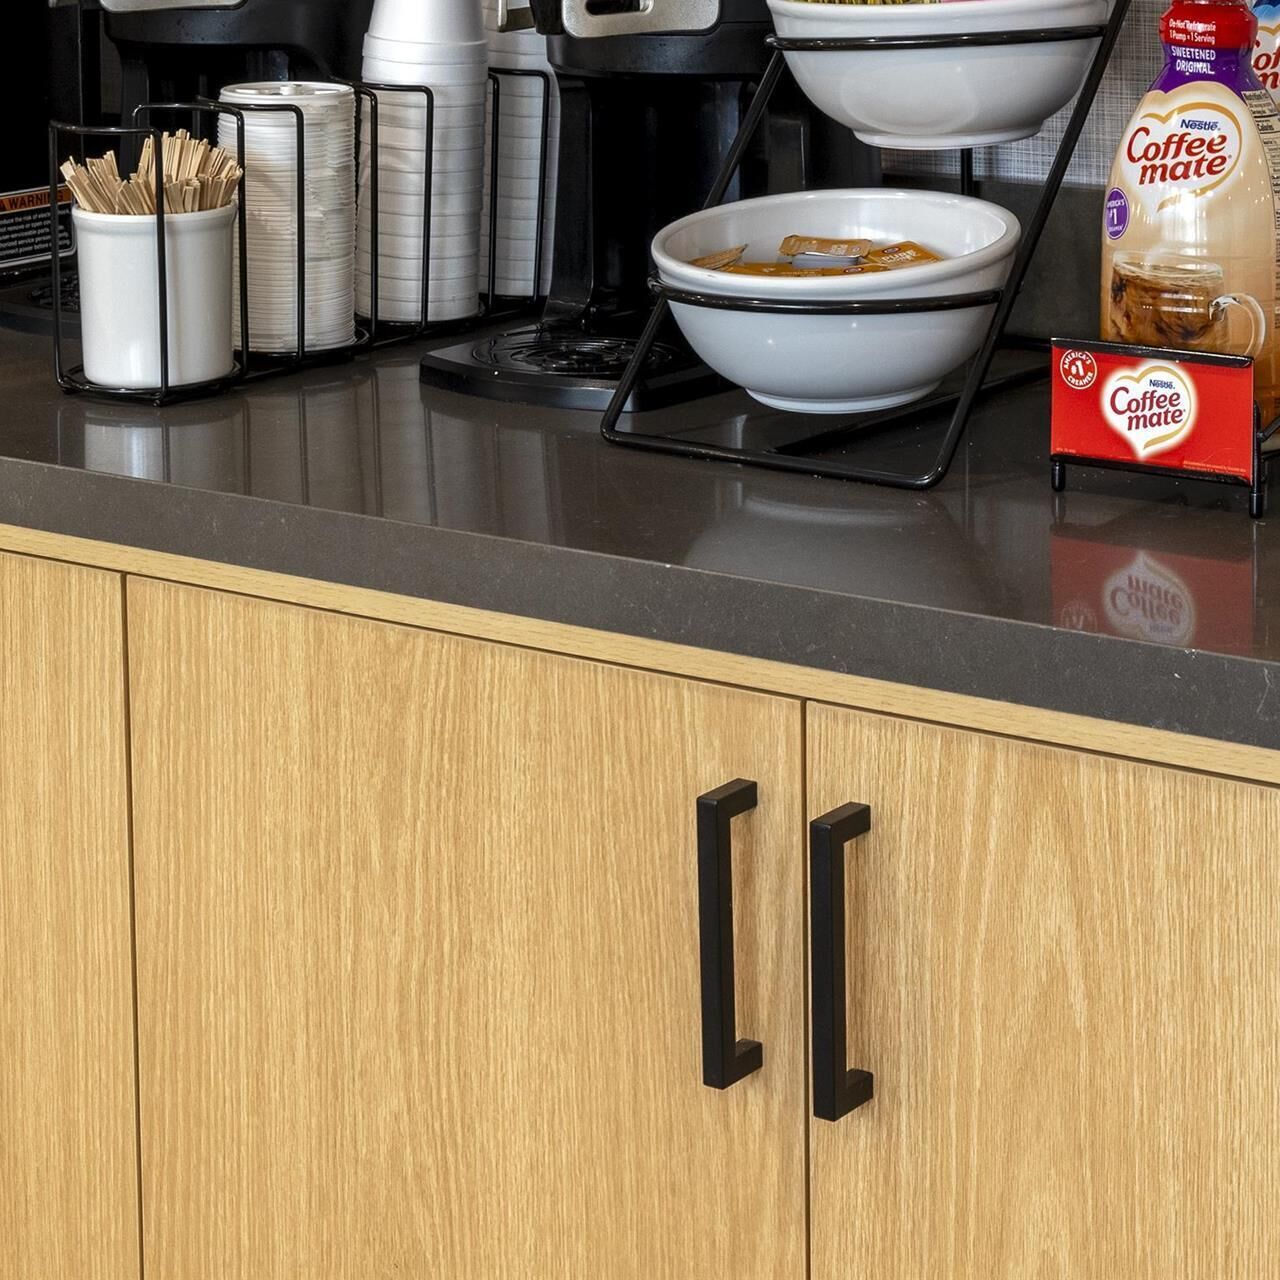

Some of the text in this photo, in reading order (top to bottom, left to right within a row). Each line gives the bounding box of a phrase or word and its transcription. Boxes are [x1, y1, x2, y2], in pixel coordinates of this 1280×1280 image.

[1194, 32, 1216, 46] Serving
[1171, 46, 1216, 60] SWEETENED
[1176, 59, 1215, 74] ORIGINAL
[1127, 126, 1227, 164] Coffee
[1139, 154, 1227, 185] mate
[9, 192, 64, 210] WARNIG
[1071, 360, 1085, 376] #1
[1110, 386, 1181, 415] Coffee
[1127, 407, 1183, 431] mate
